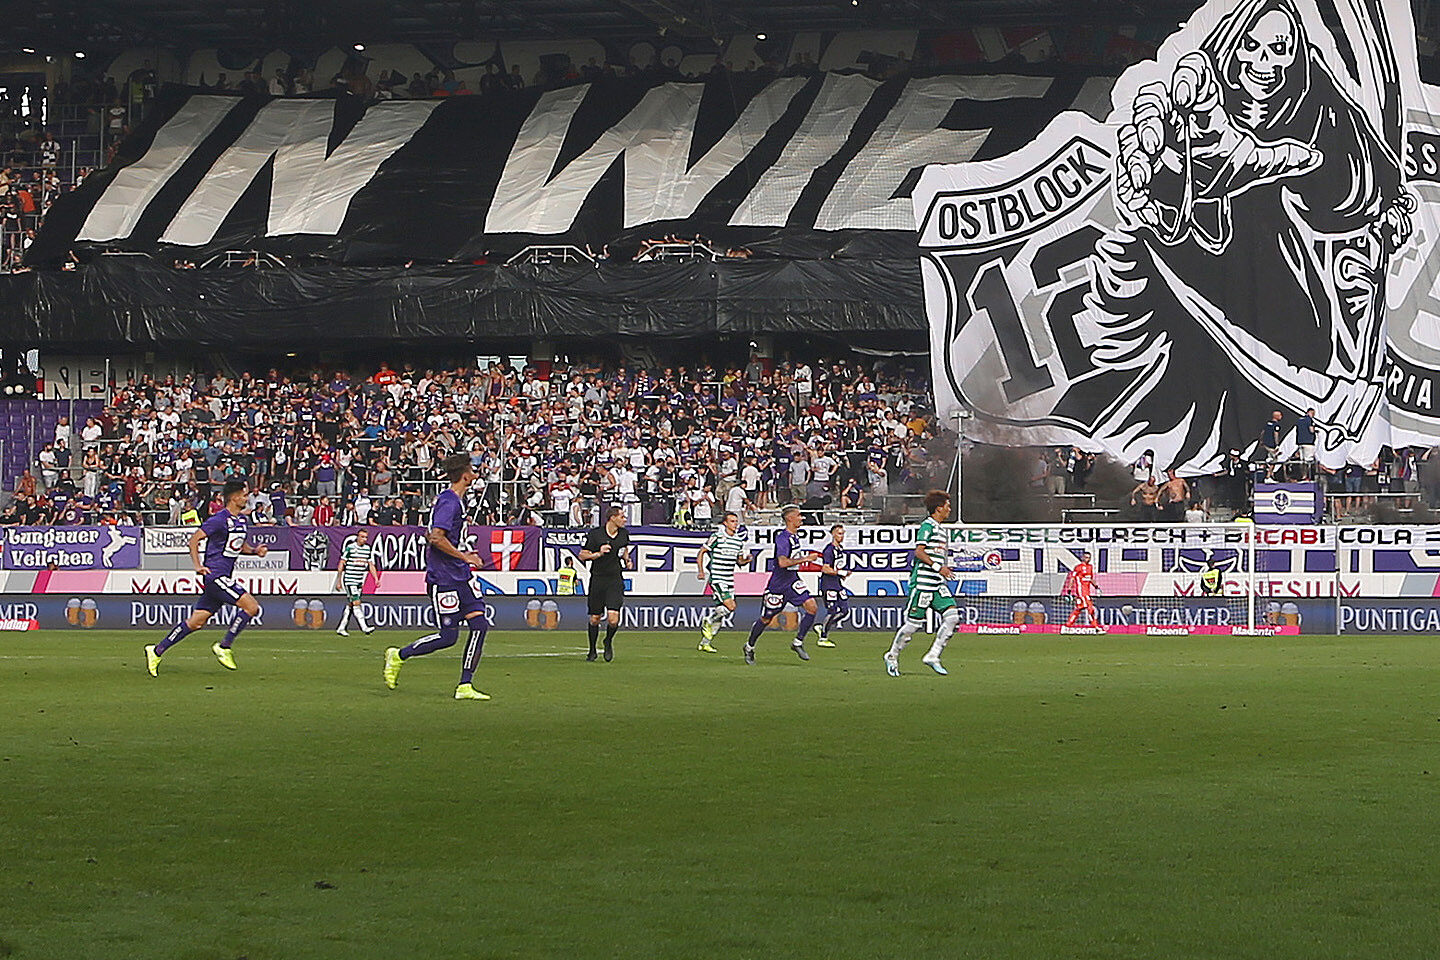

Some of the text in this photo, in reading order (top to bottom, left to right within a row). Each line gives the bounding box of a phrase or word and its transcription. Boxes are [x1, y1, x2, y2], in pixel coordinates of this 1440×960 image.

[76, 92, 446, 246] IN
[940, 149, 1109, 240] OSTBLOCK
[8, 527, 99, 548] Lungauer
[251, 533, 277, 544] 1970
[545, 531, 588, 546] SEKT
[858, 527, 917, 545] HOU
[1338, 527, 1413, 545] COLA
[11, 549, 95, 568] Veilchen
[977, 625, 1021, 636] Magenta
[1146, 626, 1189, 636] Magenta
